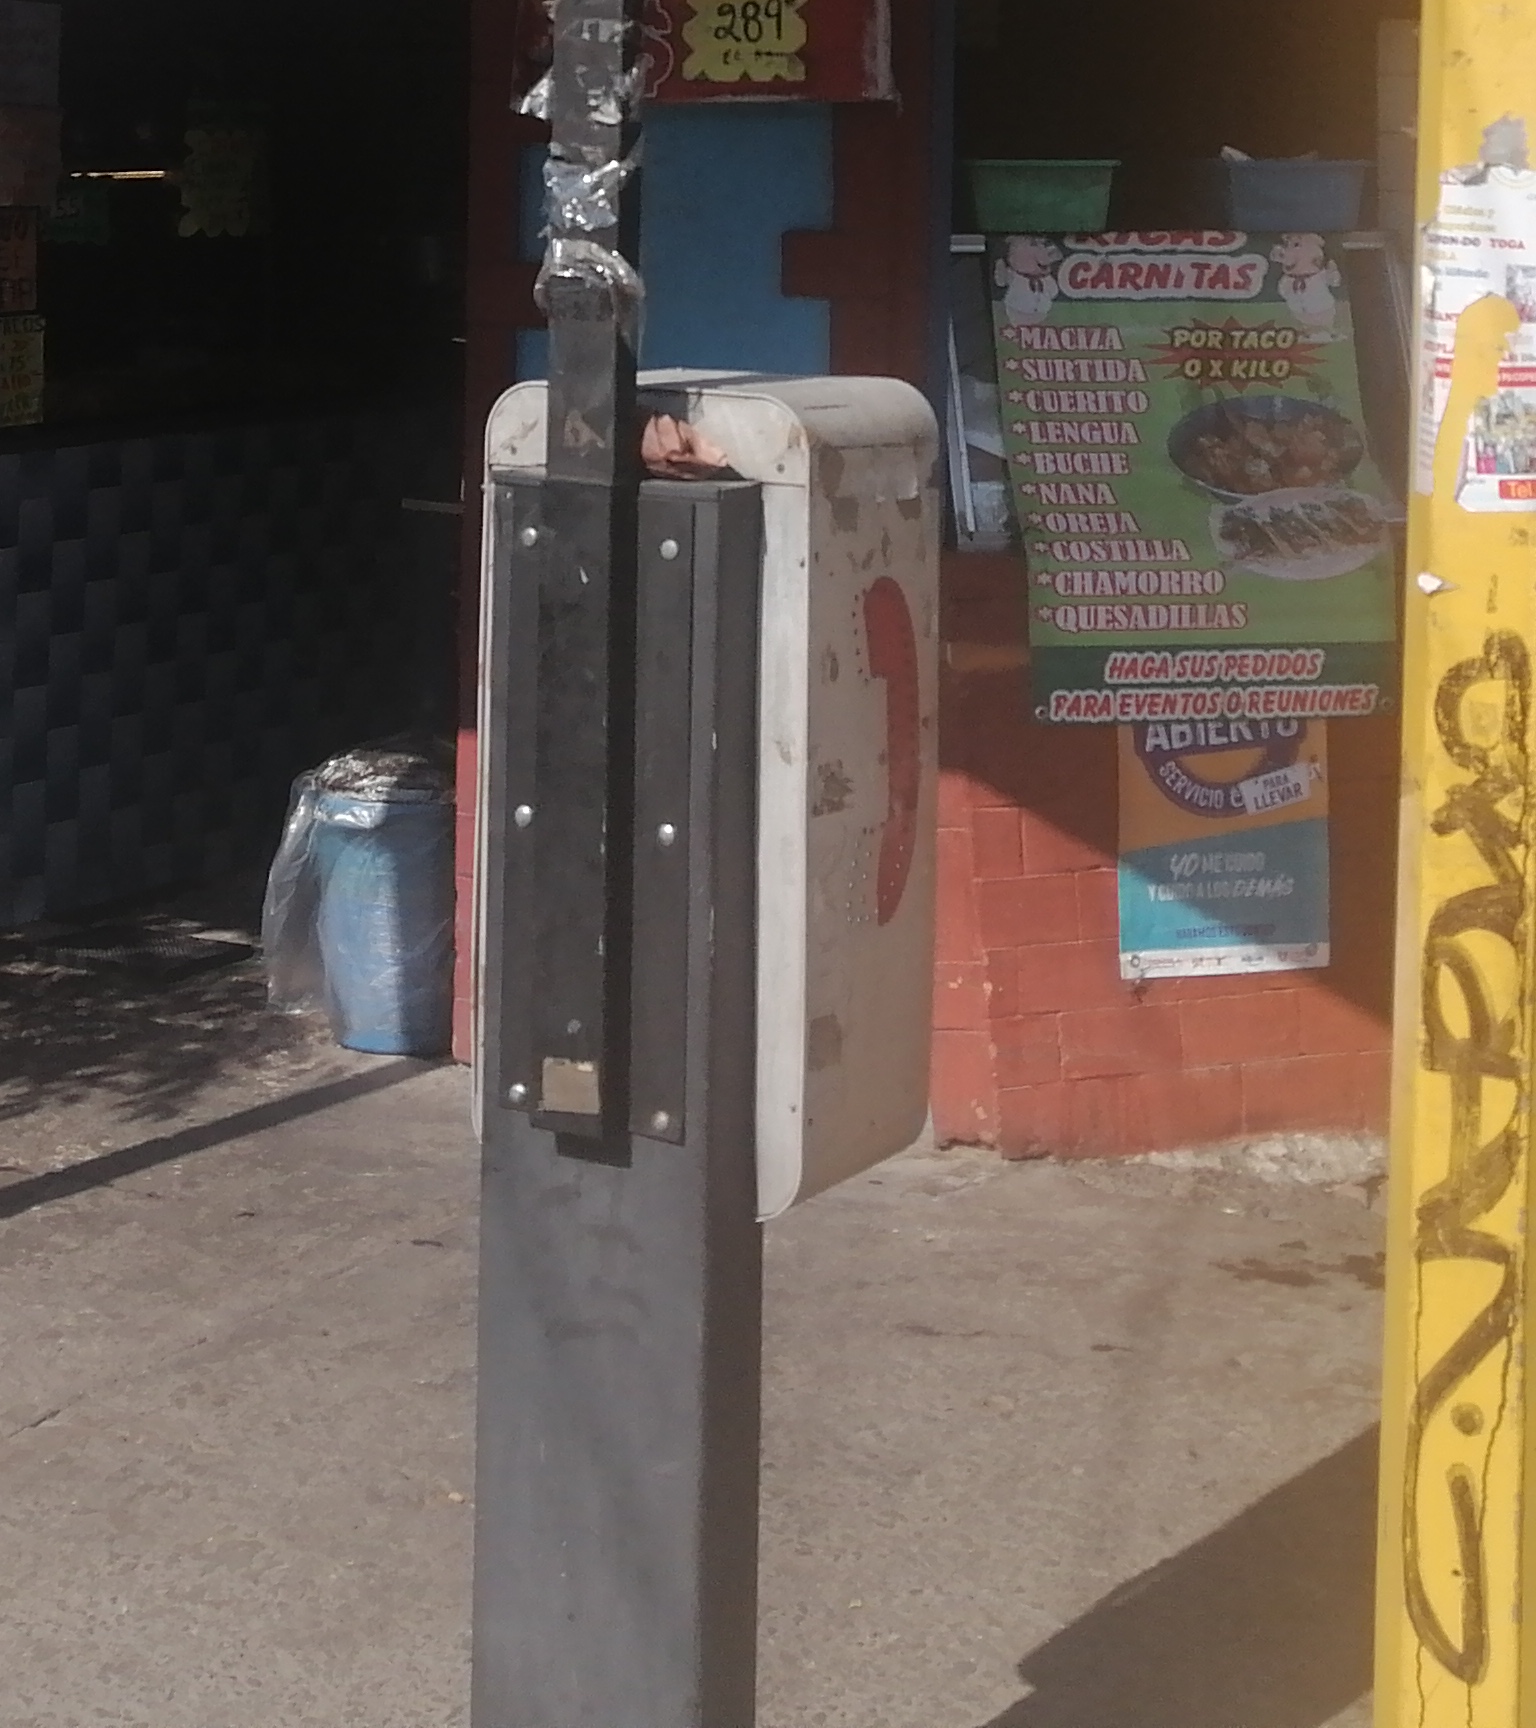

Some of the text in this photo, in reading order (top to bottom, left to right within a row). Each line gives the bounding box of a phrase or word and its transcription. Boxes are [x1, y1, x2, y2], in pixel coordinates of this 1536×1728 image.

[1067, 260, 1258, 292] CARNITAS
[1018, 326, 1297, 351] MACIZA POR TACO
[1019, 357, 1150, 383] SURTIDA
[1207, 358, 1223, 379] X
[1230, 358, 1292, 380] KILO
[1025, 390, 1150, 414] CUERITO
[1028, 421, 1142, 445] LENGUA
[1034, 452, 1131, 475] BUCHE
[1039, 482, 1118, 506] NANA
[1044, 511, 1141, 534] OREJA
[1049, 539, 1192, 562] COSTILLA
[1054, 570, 1227, 596] CHAMORRO
[1055, 603, 1249, 633] QUESADILLAS
[1108, 652, 1323, 681] HAGA SUS PEDIDOS
[1052, 688, 1378, 719] PARA EVENTOS O REUNIONES
[1159, 760, 1226, 810] SERVICIO
[1262, 772, 1290, 791] PARA
[1253, 782, 1305, 811] LLEVAR
